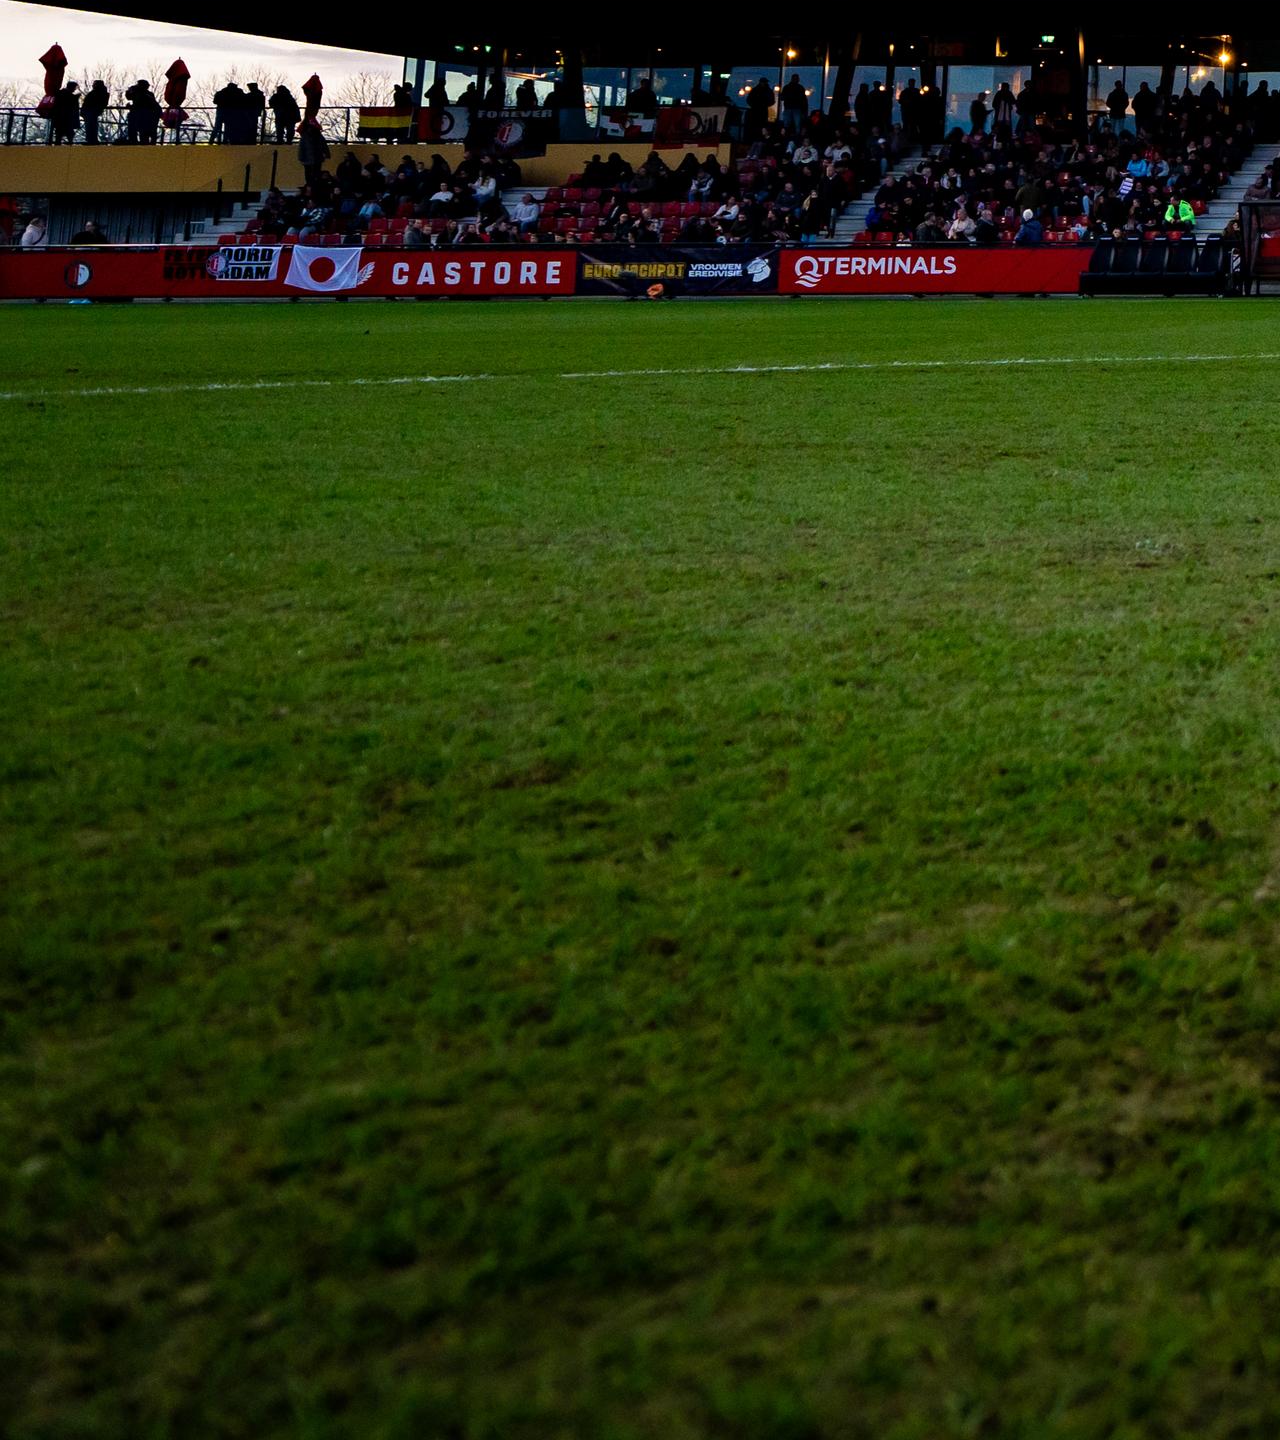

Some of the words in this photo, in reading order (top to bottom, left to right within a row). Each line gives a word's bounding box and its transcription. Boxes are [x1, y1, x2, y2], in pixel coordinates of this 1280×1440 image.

[391, 262, 562, 285] CASTORE
[689, 270, 743, 278] EREDIVISIE
[795, 256, 957, 288] QTERMINALS
